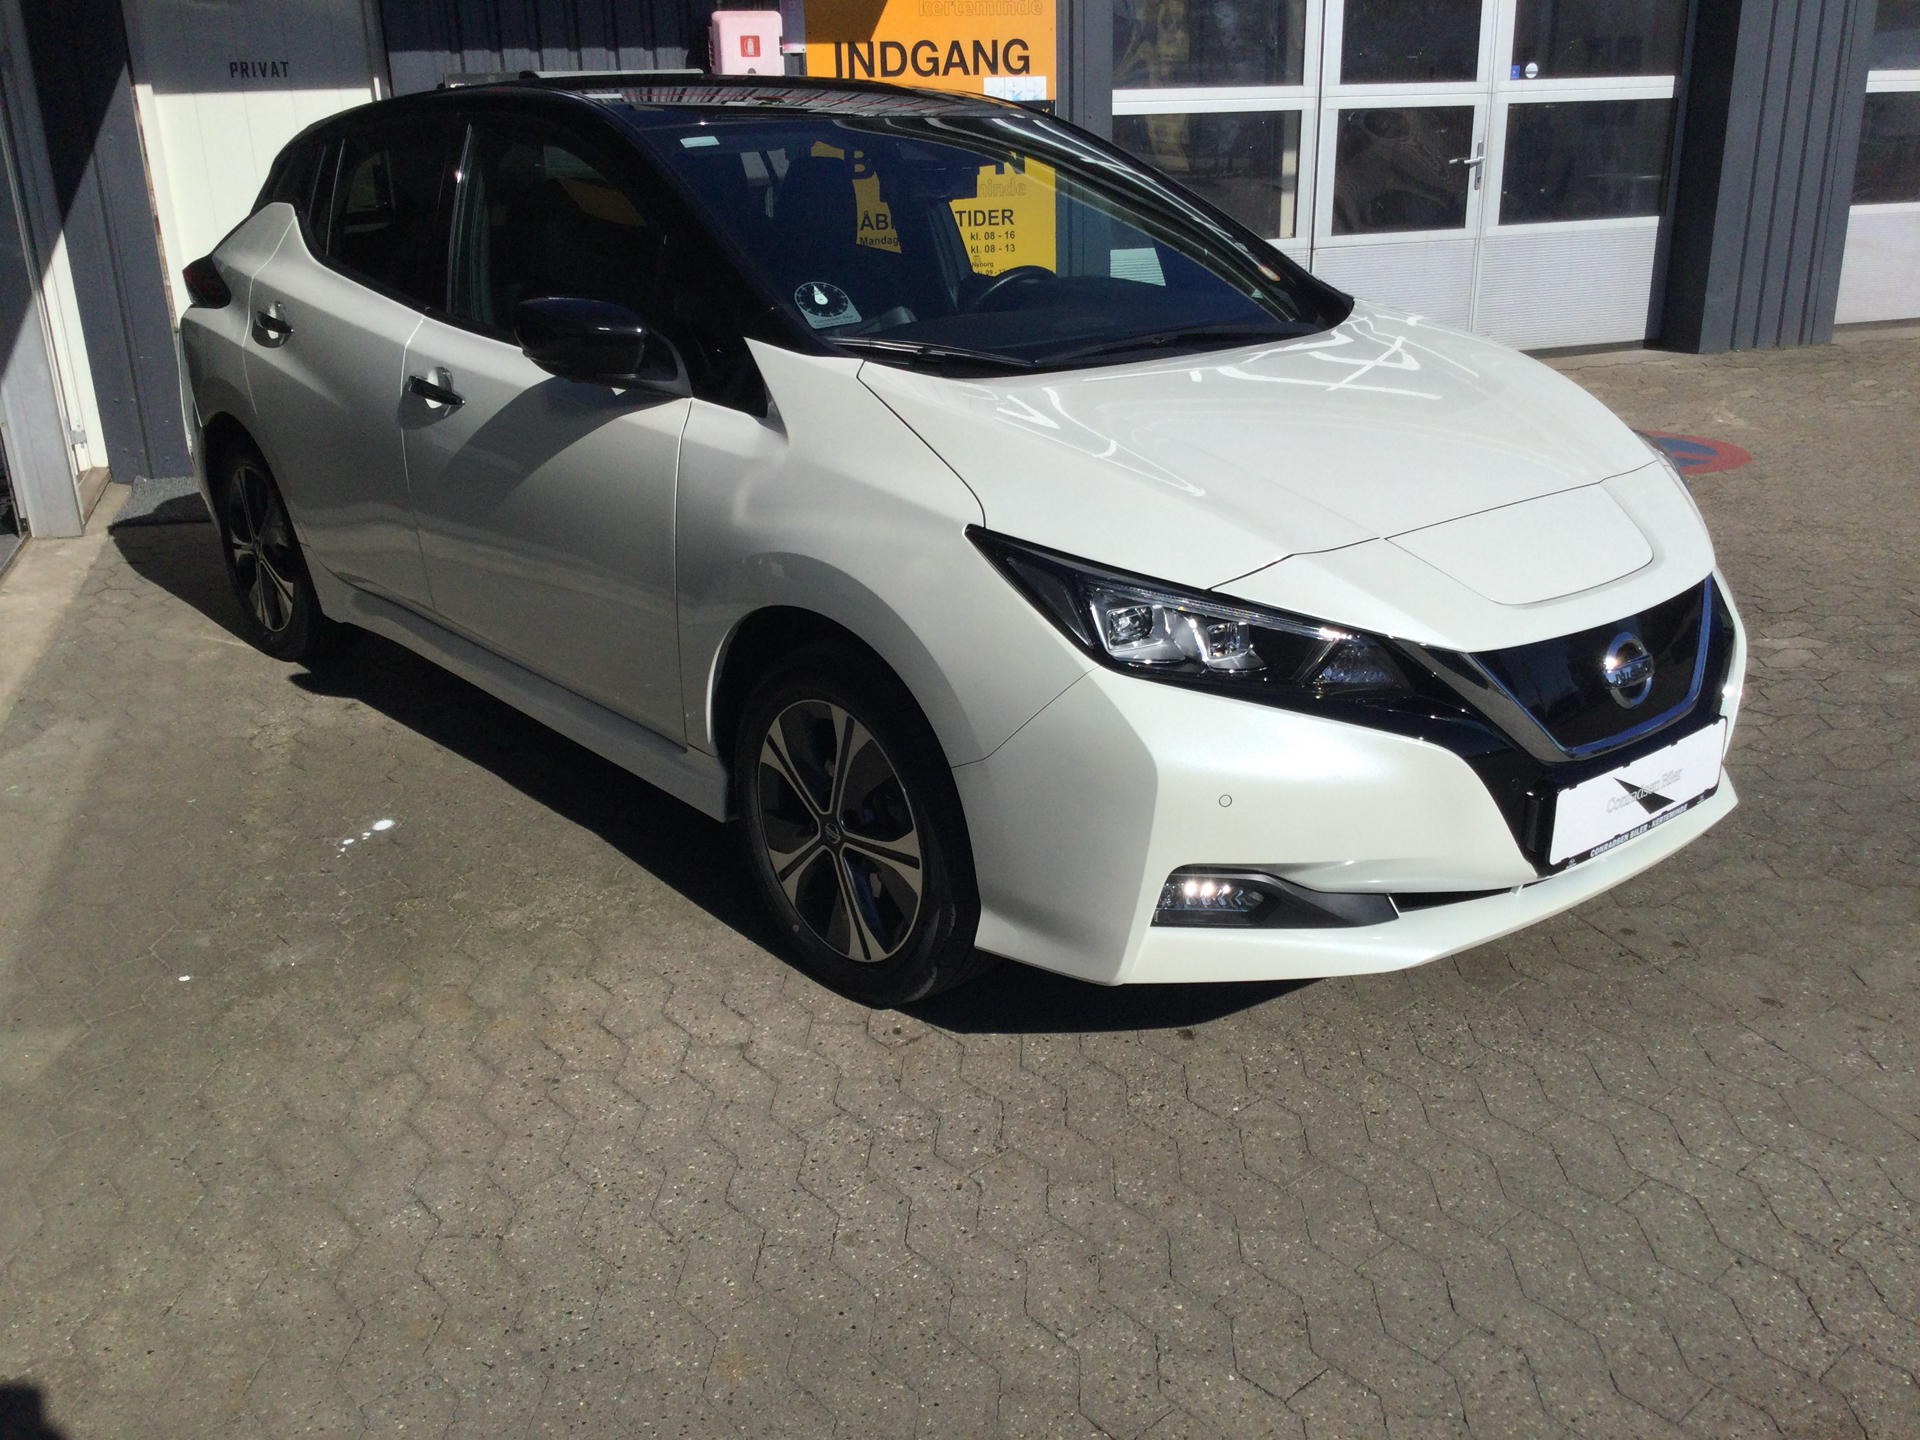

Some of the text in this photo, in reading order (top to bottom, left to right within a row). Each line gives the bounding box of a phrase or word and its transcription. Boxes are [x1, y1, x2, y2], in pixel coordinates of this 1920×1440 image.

[918, 0, 1043, 16] kerteminde
[834, 38, 1030, 78] INDGANG
[229, 61, 289, 78] PRIVAT
[970, 232, 981, 241] kl.
[984, 231, 996, 240] 08
[1005, 230, 1016, 240] 16
[970, 245, 981, 254] kl.
[984, 244, 996, 253] 08
[1005, 243, 1016, 252] 13
[1589, 833, 1629, 858] CONRADSEN
[1629, 823, 1649, 839] BILER
